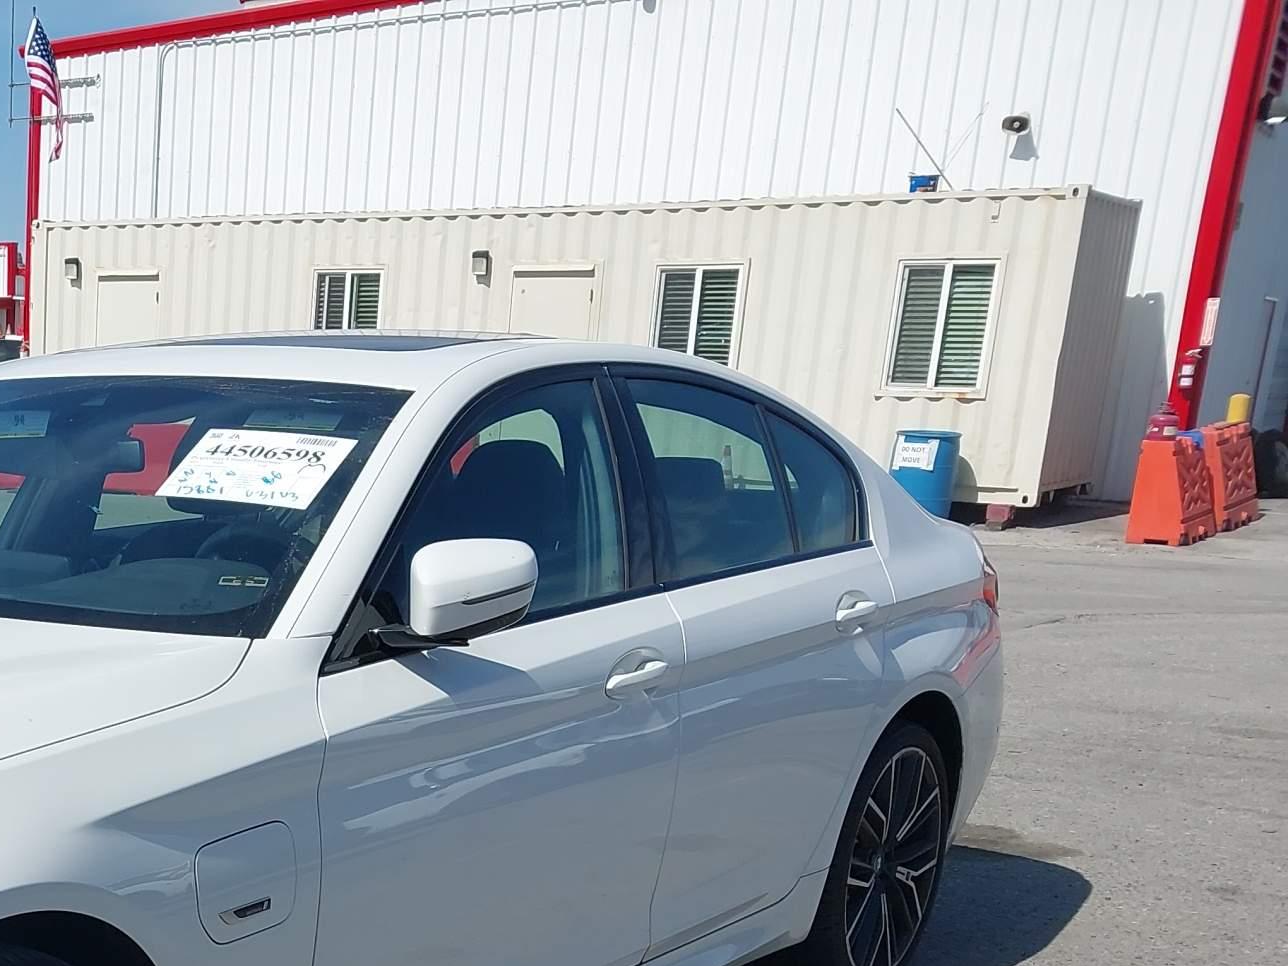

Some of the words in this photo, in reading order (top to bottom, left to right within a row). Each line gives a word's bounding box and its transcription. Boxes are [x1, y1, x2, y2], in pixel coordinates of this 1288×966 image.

[205, 443, 326, 465] 44506598
[911, 446, 926, 454] NOT
[902, 456, 920, 464] MOVE
